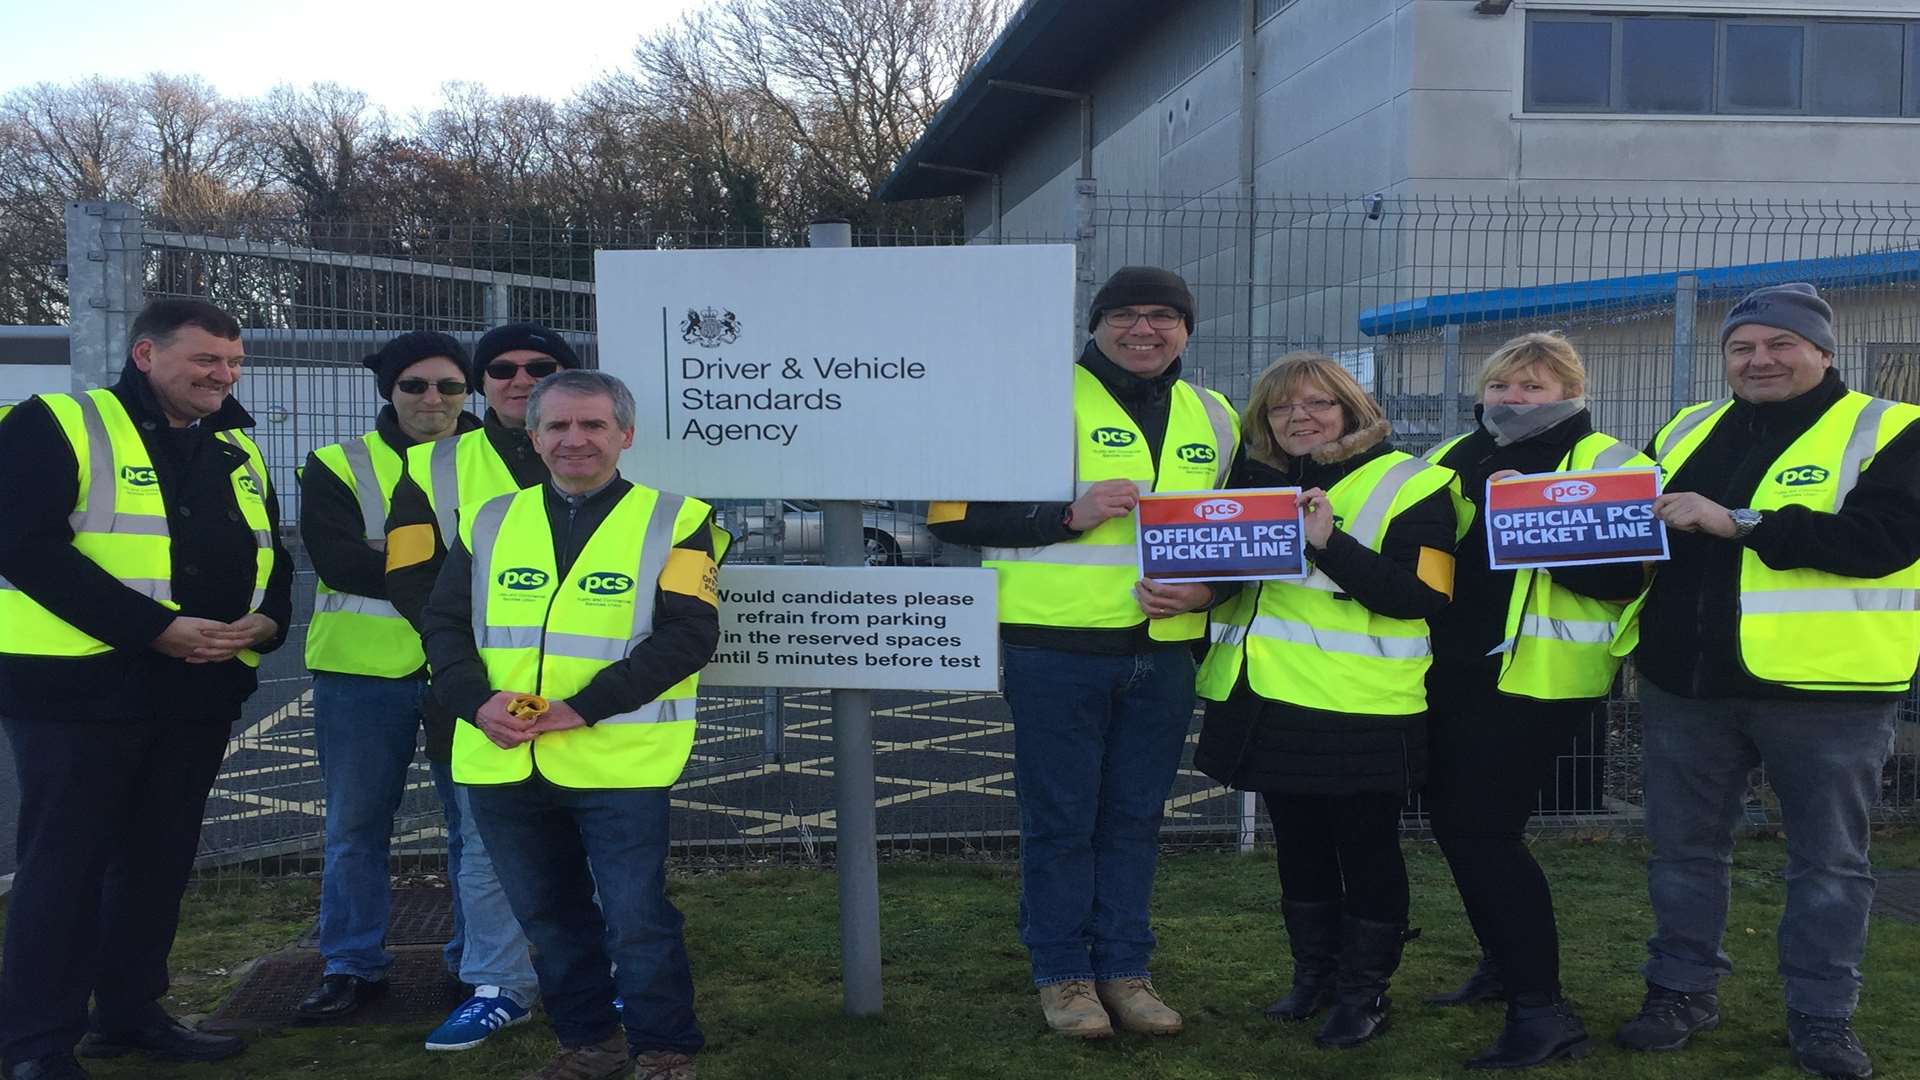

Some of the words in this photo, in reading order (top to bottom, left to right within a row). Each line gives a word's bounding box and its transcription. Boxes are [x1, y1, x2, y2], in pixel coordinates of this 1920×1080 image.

[682, 357, 772, 380] Driver
[781, 357, 804, 380] &
[813, 356, 926, 380] Vehicle
[682, 388, 842, 411] Standards
[682, 418, 798, 446] Agency
[1097, 430, 1133, 446] pcs
[1181, 447, 1214, 461] pcs
[1782, 469, 1826, 486] pcs
[1551, 484, 1590, 501] pcs
[1200, 503, 1238, 520] pcs
[1493, 509, 1601, 530] OFFICIAL
[1607, 504, 1655, 522] PCS
[1144, 526, 1247, 544] OFFICIAL
[1253, 525, 1297, 541] PCS
[1500, 526, 1588, 546] PICKET
[1594, 522, 1653, 540] LINE
[1151, 543, 1234, 561] PICKET
[1241, 541, 1293, 558] LINE
[502, 571, 546, 589] pcs
[584, 574, 629, 592] pcs
[718, 589, 775, 604] Would
[782, 590, 898, 605] candidates
[904, 591, 975, 608] please
[737, 610, 804, 624] refrain
[810, 611, 860, 625] from
[867, 612, 947, 629] parking
[724, 630, 742, 643] in
[748, 630, 781, 644] the
[787, 631, 879, 646] reserved
[885, 635, 962, 649] spaces
[757, 651, 769, 664] 5
[775, 651, 858, 666] minutes
[865, 652, 933, 667] before
[940, 654, 981, 668] test
